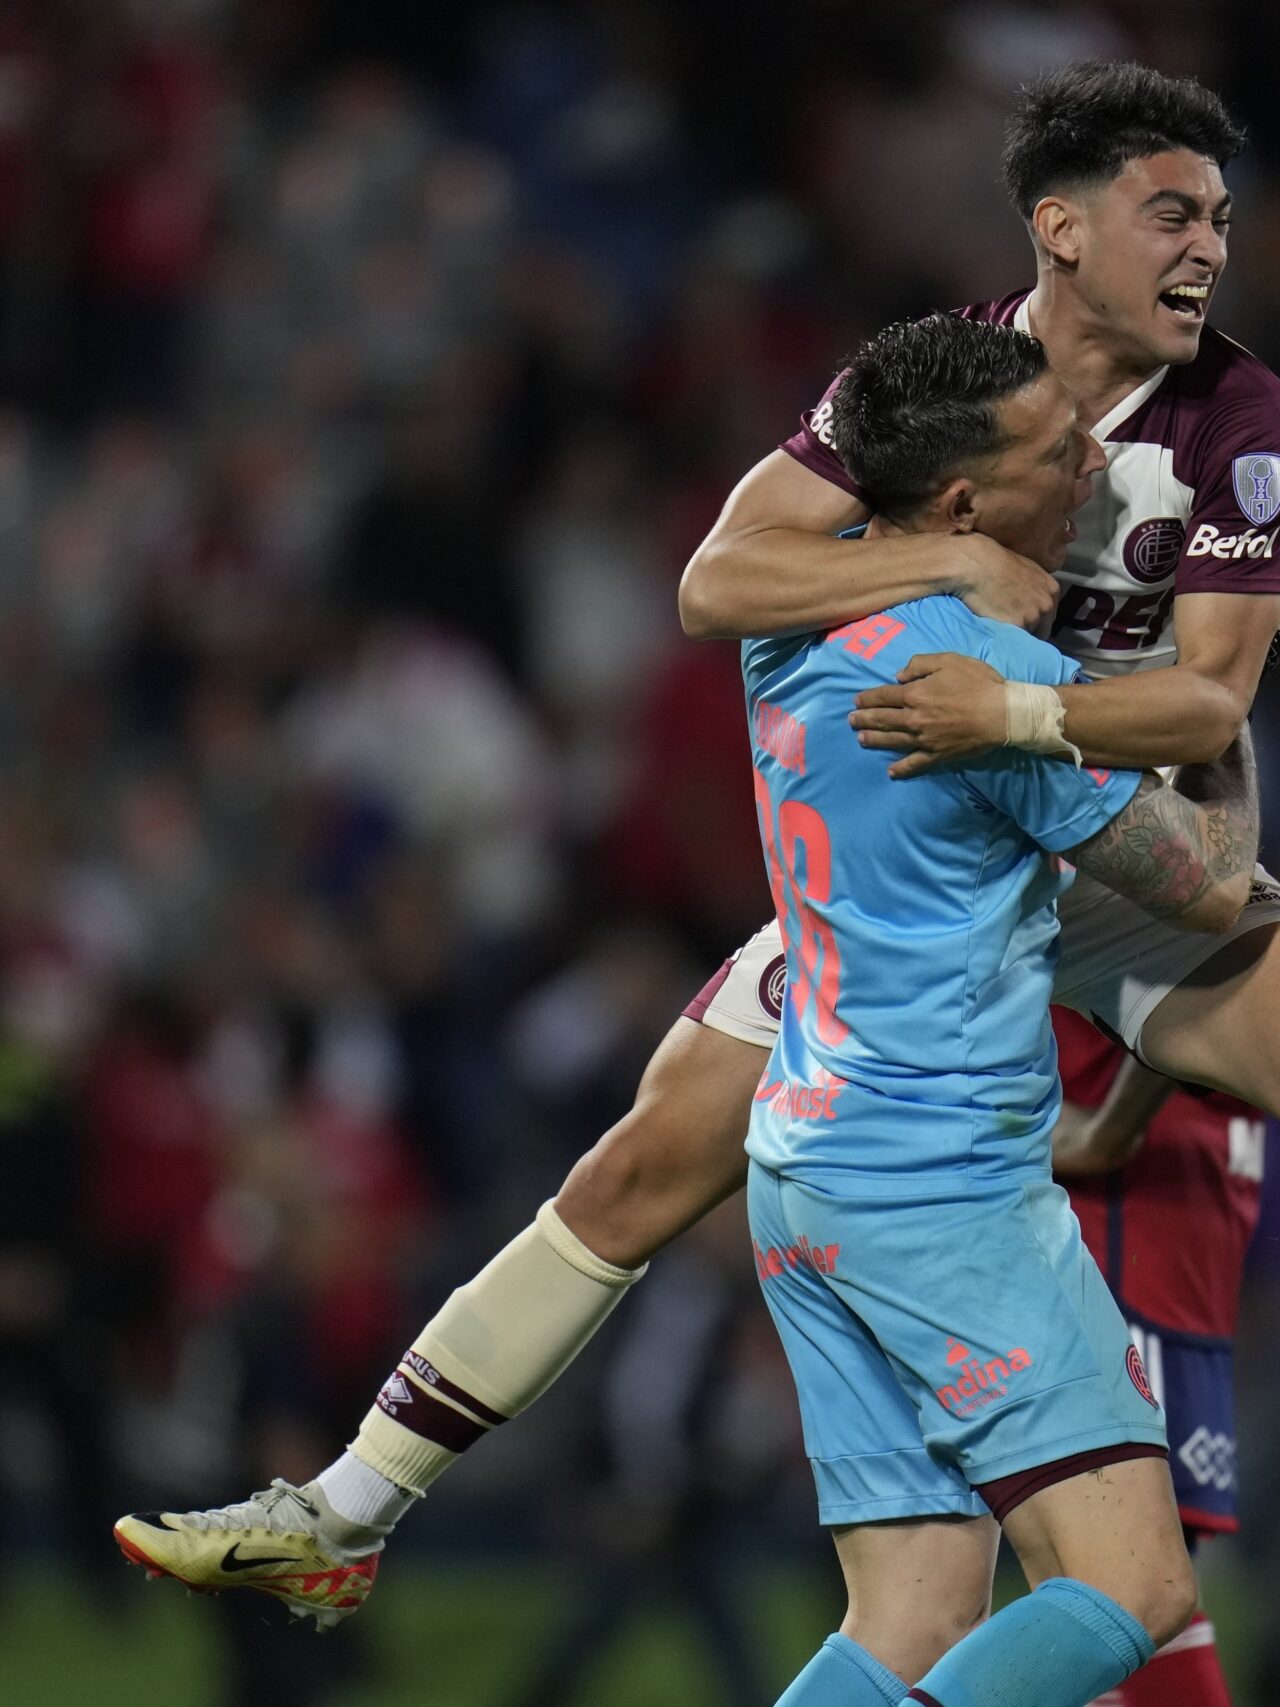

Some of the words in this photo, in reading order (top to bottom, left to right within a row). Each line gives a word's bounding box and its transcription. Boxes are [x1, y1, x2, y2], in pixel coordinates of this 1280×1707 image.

[1256, 503, 1265, 519] 1
[1186, 524, 1280, 559] Befol
[402, 1350, 440, 1386] NUS
[936, 1347, 1032, 1409] ndina
